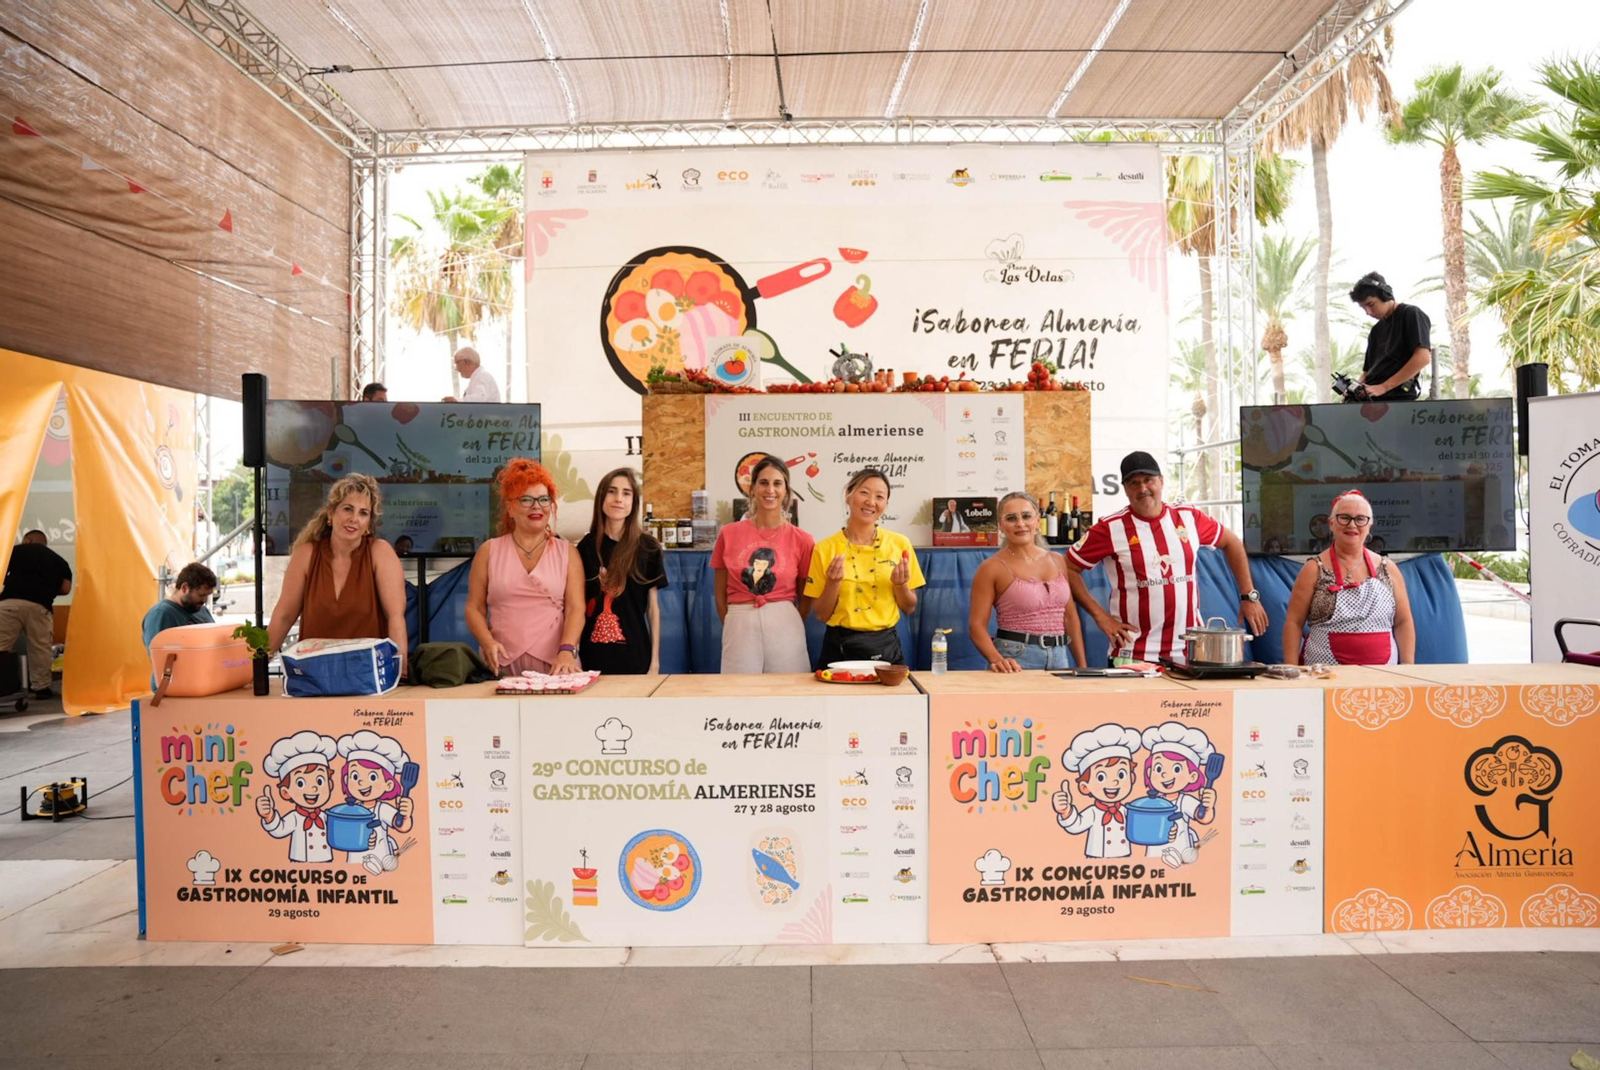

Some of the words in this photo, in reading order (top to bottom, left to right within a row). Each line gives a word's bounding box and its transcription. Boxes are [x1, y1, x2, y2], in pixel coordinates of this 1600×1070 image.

[717, 170, 749, 181] eco
[1000, 269, 1020, 285] Las
[1025, 269, 1063, 284] Velas
[1040, 308, 1142, 334] Almería
[948, 352, 979, 371] en
[738, 412, 751, 422] III
[753, 412, 815, 421] ENCUENTRO
[820, 412, 833, 421] DE
[738, 424, 836, 438] GASTRONOMÍA
[838, 424, 924, 437] almeriense
[462, 440, 482, 452] en
[1435, 436, 1455, 447] en
[466, 455, 479, 463] del
[493, 455, 501, 463] al
[883, 452, 925, 463] Almería
[1438, 452, 1453, 460] del
[1467, 452, 1476, 460] al
[1549, 475, 1566, 490] EL
[1180, 707, 1210, 718] FERIA!
[373, 717, 403, 727] FERIA!
[769, 717, 823, 731] Almería
[161, 724, 236, 763] mini
[721, 739, 738, 750] en
[743, 732, 800, 750] FERIA!
[951, 717, 1033, 760] mini
[565, 759, 681, 776] CONCURSO
[684, 759, 707, 776] de
[532, 779, 691, 801] GASTRONOMÍA
[694, 783, 816, 800] ALMERIENSE
[1242, 790, 1266, 799] eco
[439, 800, 463, 808] eco
[842, 797, 867, 806] eco
[734, 804, 748, 815] 27
[750, 805, 758, 816] y
[759, 803, 773, 814] 28
[775, 803, 816, 816] agosto
[1454, 831, 1574, 868] Almería
[225, 869, 242, 884] IX
[249, 868, 348, 885] CONCURSO
[352, 875, 367, 885] DE
[1015, 866, 1034, 882] IX
[1041, 864, 1146, 881] CONCURSO
[1150, 868, 1165, 879] DE
[1454, 871, 1492, 879] Asociación
[1495, 870, 1521, 878] Almería
[1524, 869, 1574, 877] Gastronómica
[177, 884, 310, 903] GASTRONOMÍA
[317, 889, 399, 904] INFANTIL
[962, 881, 1105, 903] GASTRONOMÍA
[1112, 882, 1196, 900] INFANTIL
[268, 908, 281, 918] 29
[283, 908, 320, 920] agosto
[1060, 906, 1074, 917] 29
[1076, 904, 1115, 917] agosto
